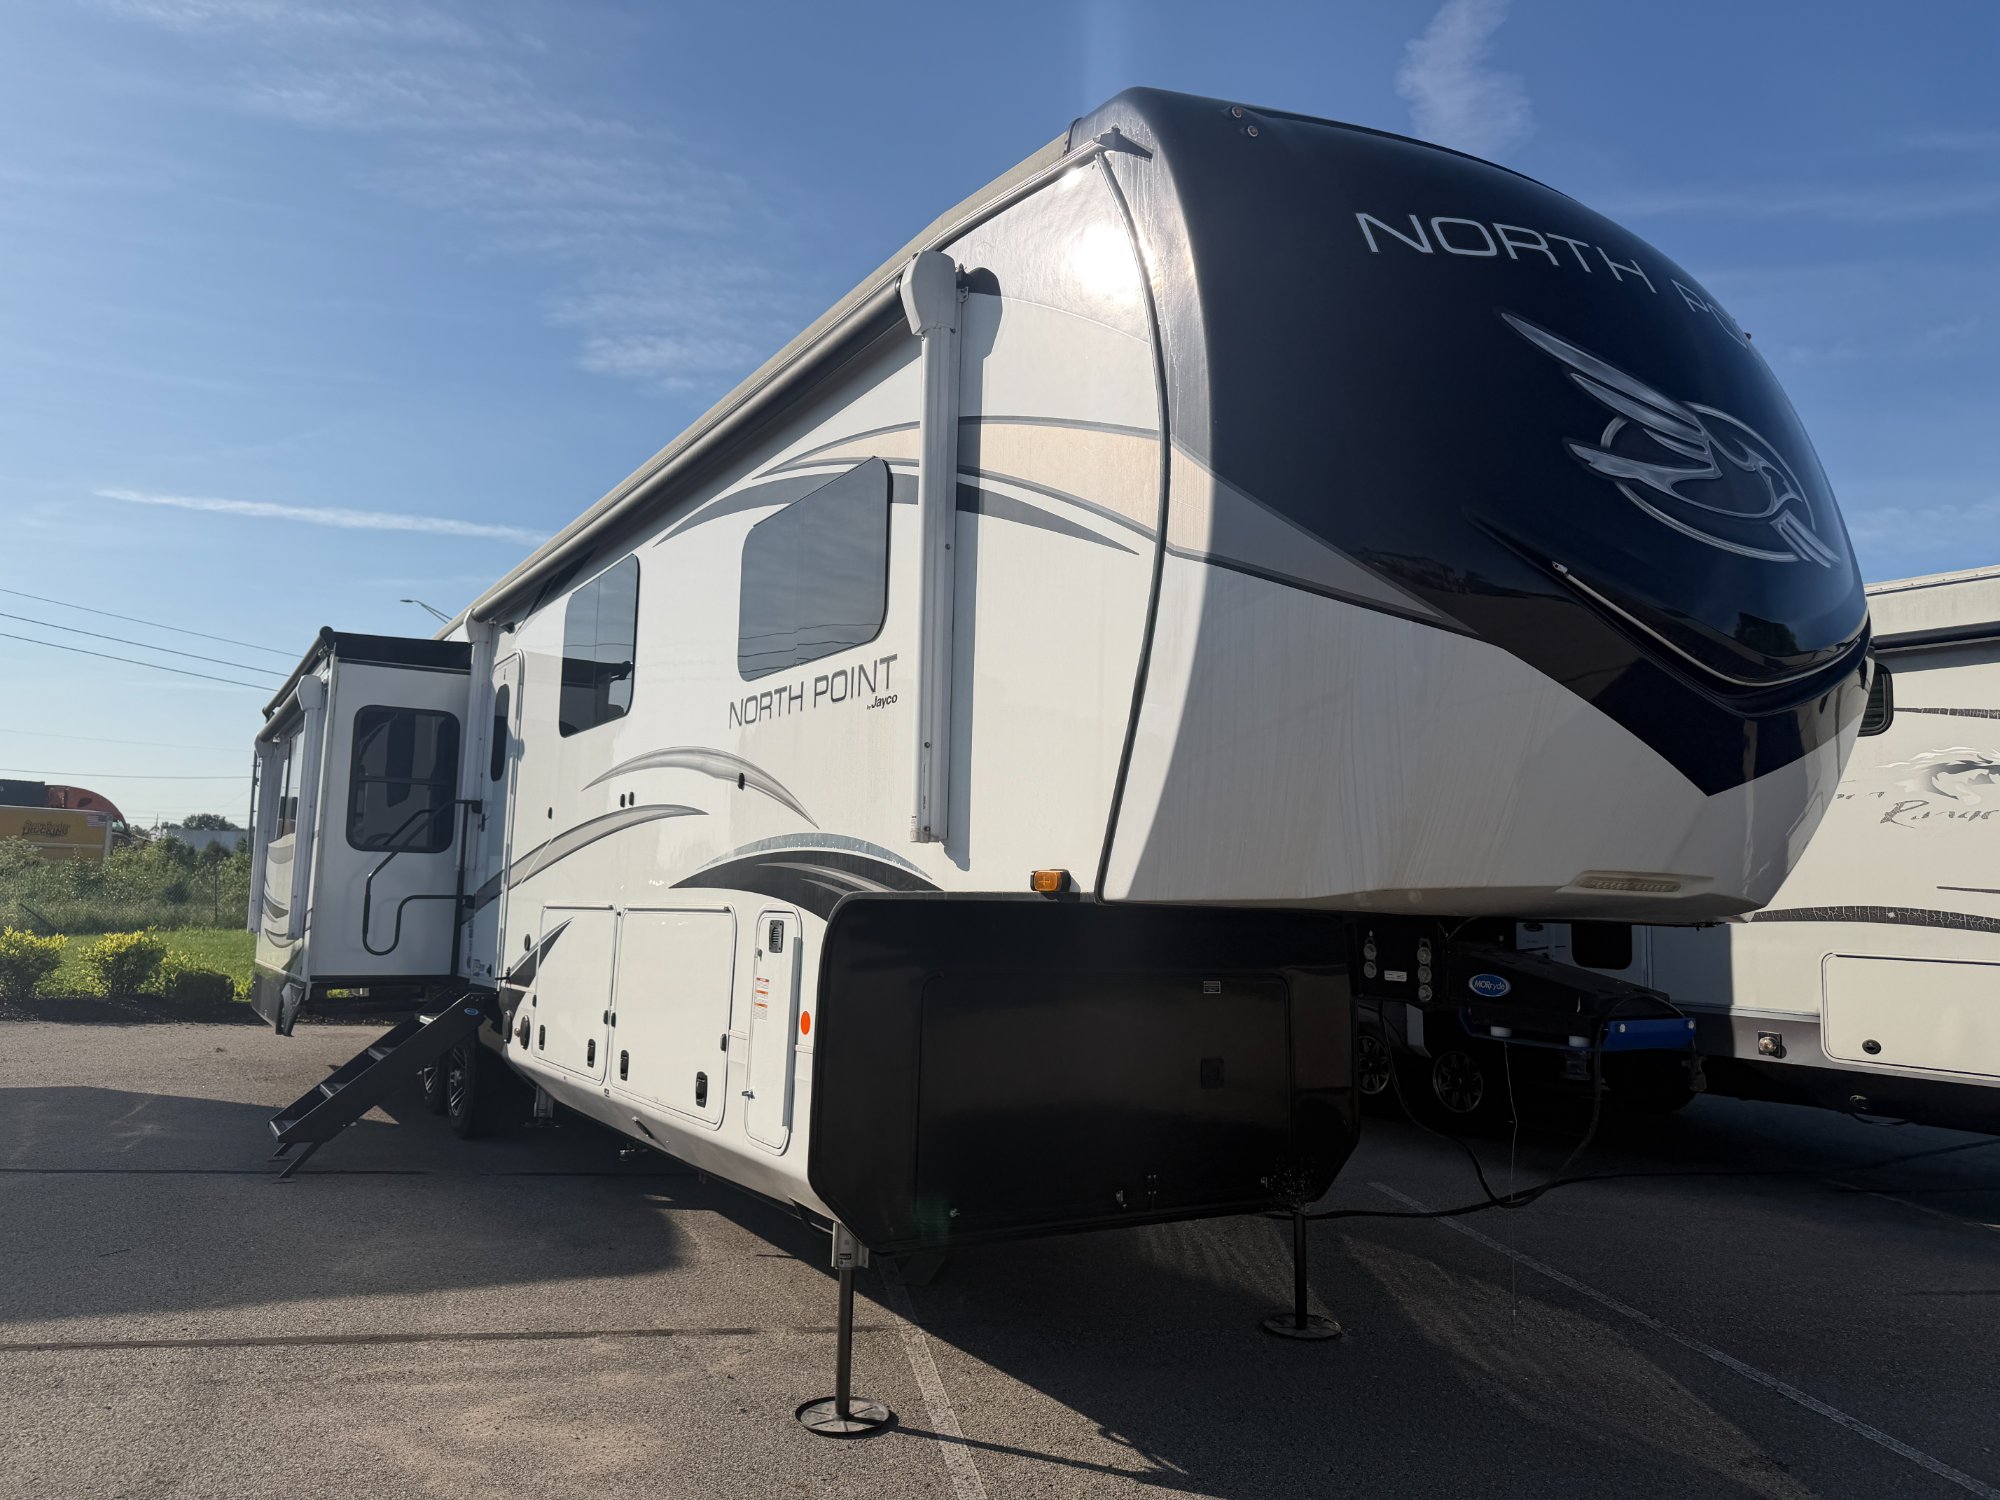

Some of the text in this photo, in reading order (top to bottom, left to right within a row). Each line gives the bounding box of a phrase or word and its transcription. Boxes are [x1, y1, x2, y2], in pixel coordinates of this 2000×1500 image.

[1355, 212, 1658, 294] NORTH
[729, 653, 898, 729] NORTH POINT
[871, 693, 898, 710] Jayco
